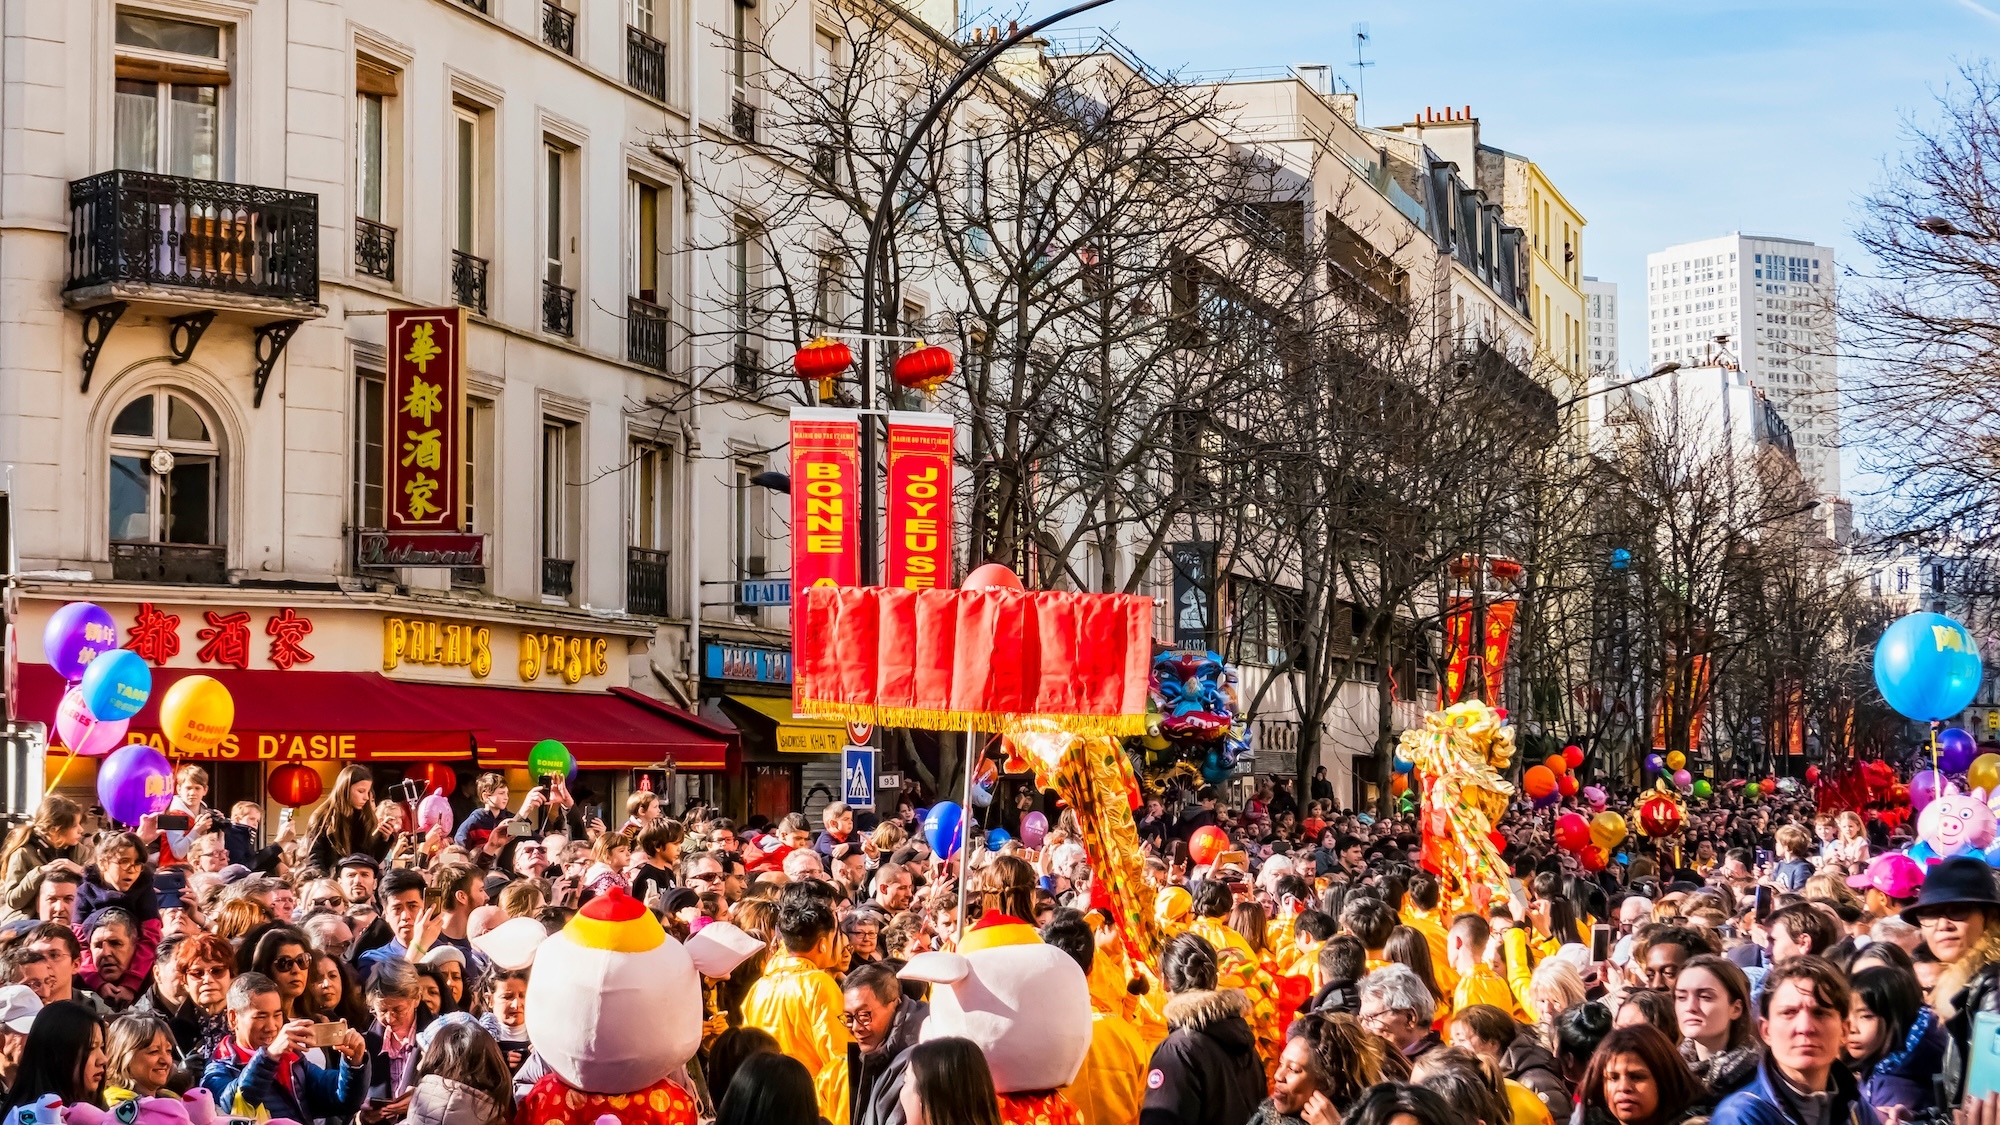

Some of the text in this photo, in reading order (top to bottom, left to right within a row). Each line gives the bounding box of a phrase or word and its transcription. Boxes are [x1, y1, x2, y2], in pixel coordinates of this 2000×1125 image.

[400, 321, 442, 520] 華都酒家
[806, 463, 843, 553] BONNE
[905, 467, 937, 590] JOYEUSE
[361, 535, 481, 563] Restaurant
[745, 584, 774, 601] KHAI
[384, 617, 607, 684] PALAIS D'ASIE
[723, 649, 787, 680] KHAI TRI
[188, 719, 227, 734] BONNE
[258, 735, 356, 758] D'ASIE
[810, 734, 826, 749] KHAI
[537, 759, 563, 767] BONNE
[884, 777, 895, 786] 93
